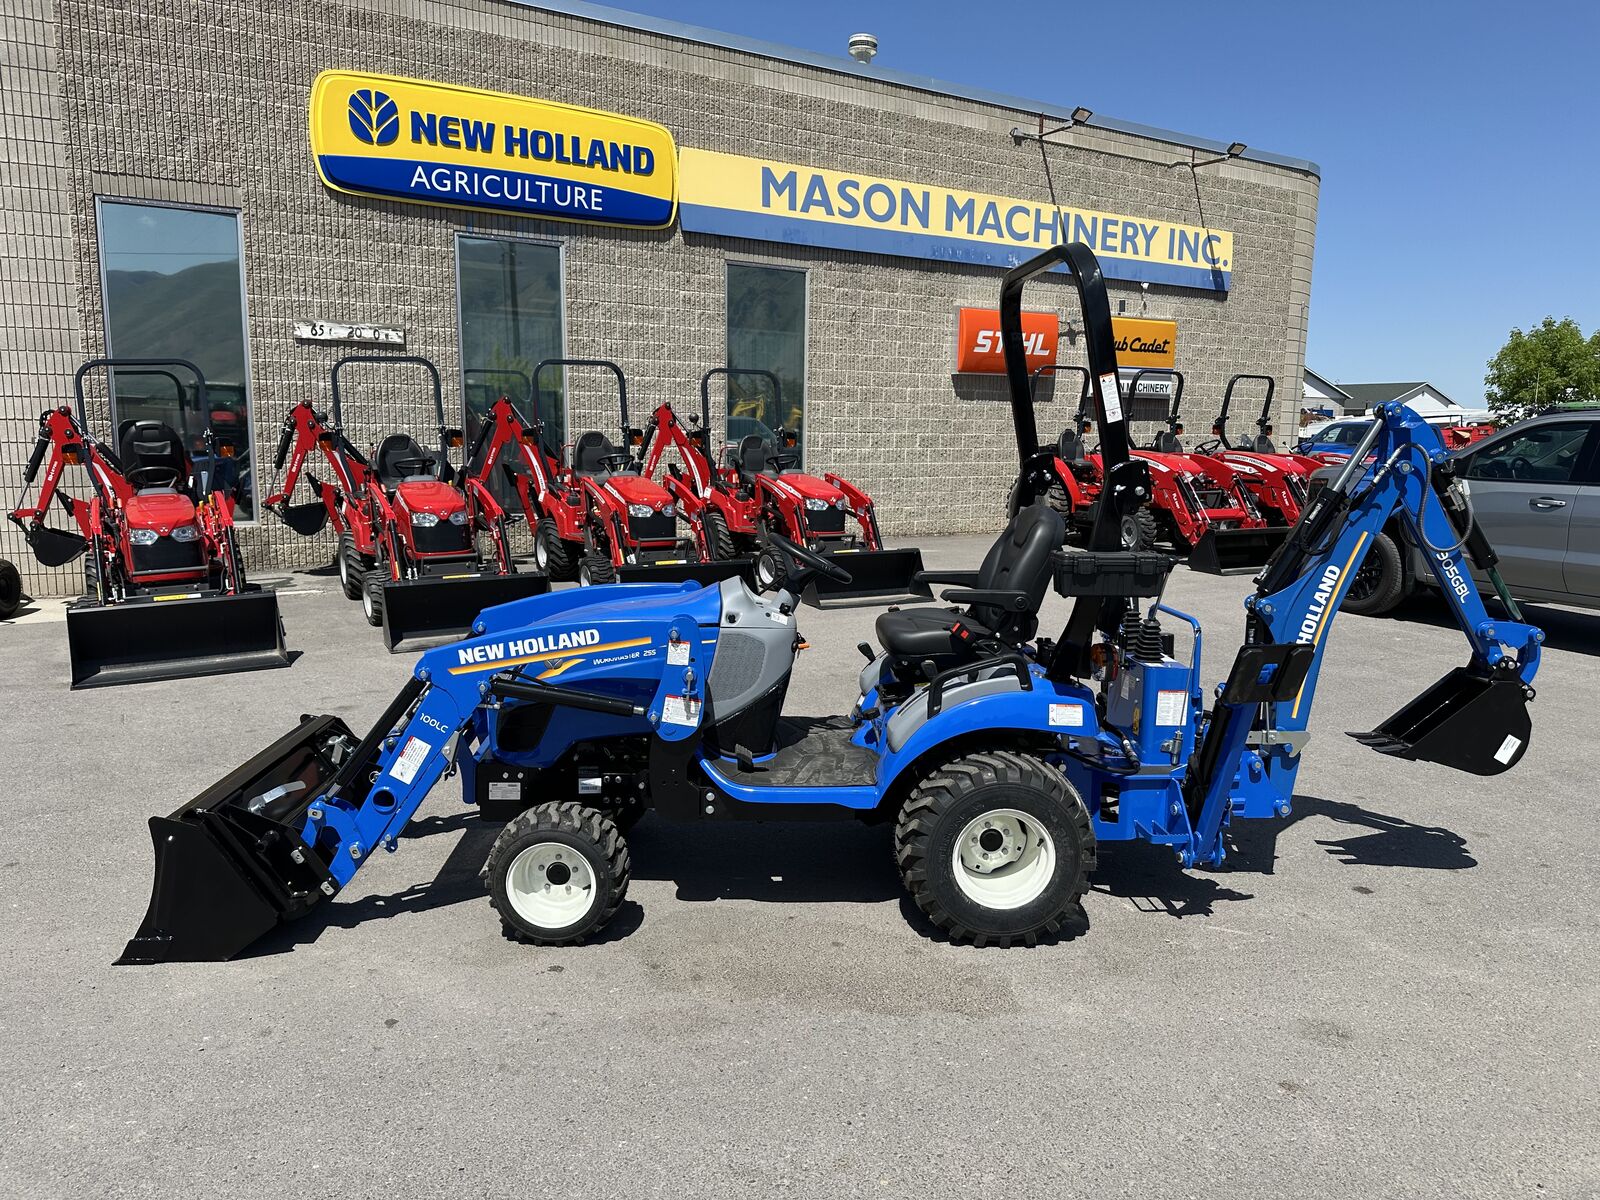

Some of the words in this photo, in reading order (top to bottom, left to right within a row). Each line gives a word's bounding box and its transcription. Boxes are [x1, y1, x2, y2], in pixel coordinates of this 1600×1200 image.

[411, 111, 495, 153] NEW
[504, 125, 655, 176] HOLLAND
[409, 165, 603, 211] AGRICULTURE
[761, 166, 930, 229] MASON
[945, 194, 1159, 256] MACHINERY
[1168, 228, 1229, 267] INC.
[973, 330, 1050, 356] STHL
[1114, 336, 1128, 352] ub
[1130, 336, 1170, 354] Cadet
[1295, 565, 1341, 645] HOLLAND
[458, 643, 504, 665] NEW
[509, 629, 600, 657] HOLLAND
[420, 713, 449, 734] 100LC
